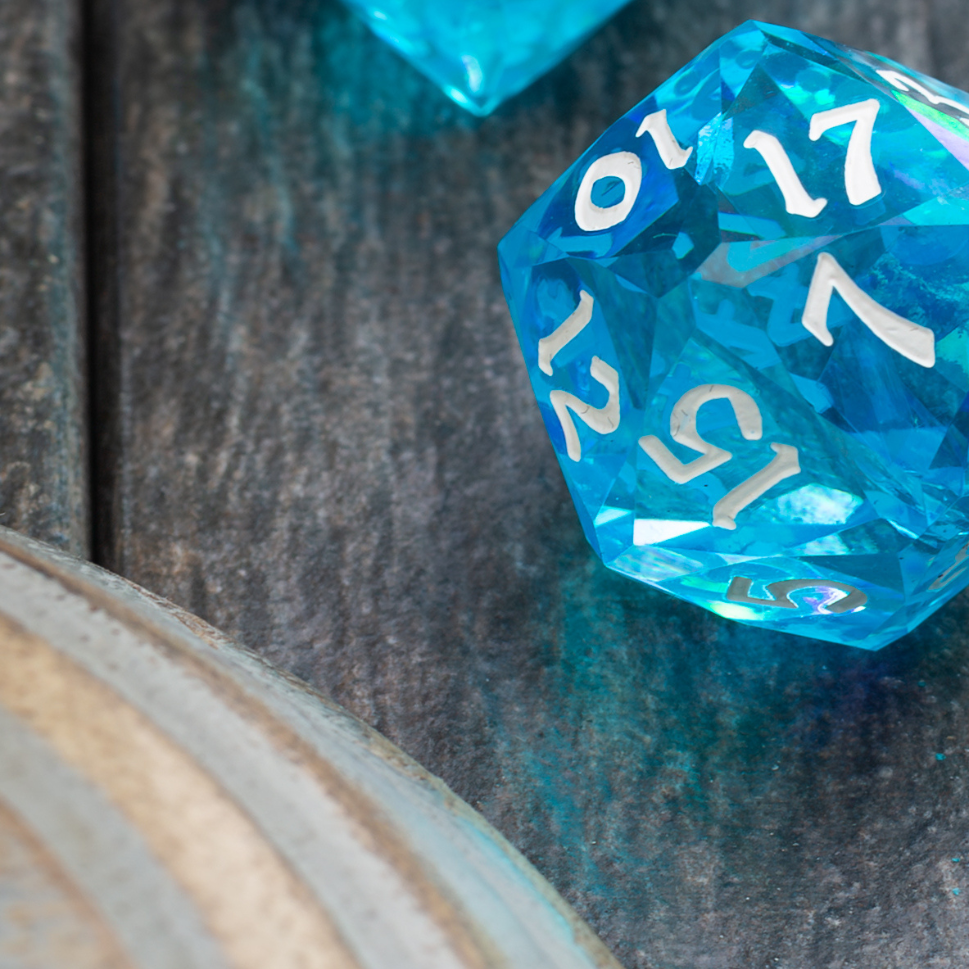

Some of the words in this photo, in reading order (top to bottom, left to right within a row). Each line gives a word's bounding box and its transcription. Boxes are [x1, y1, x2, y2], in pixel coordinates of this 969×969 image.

[574, 108, 693, 231] 10
[743, 98, 881, 219] 17
[802, 251, 936, 369] 7
[538, 289, 621, 462] 12
[638, 383, 801, 531] 15
[726, 575, 869, 614] 5
